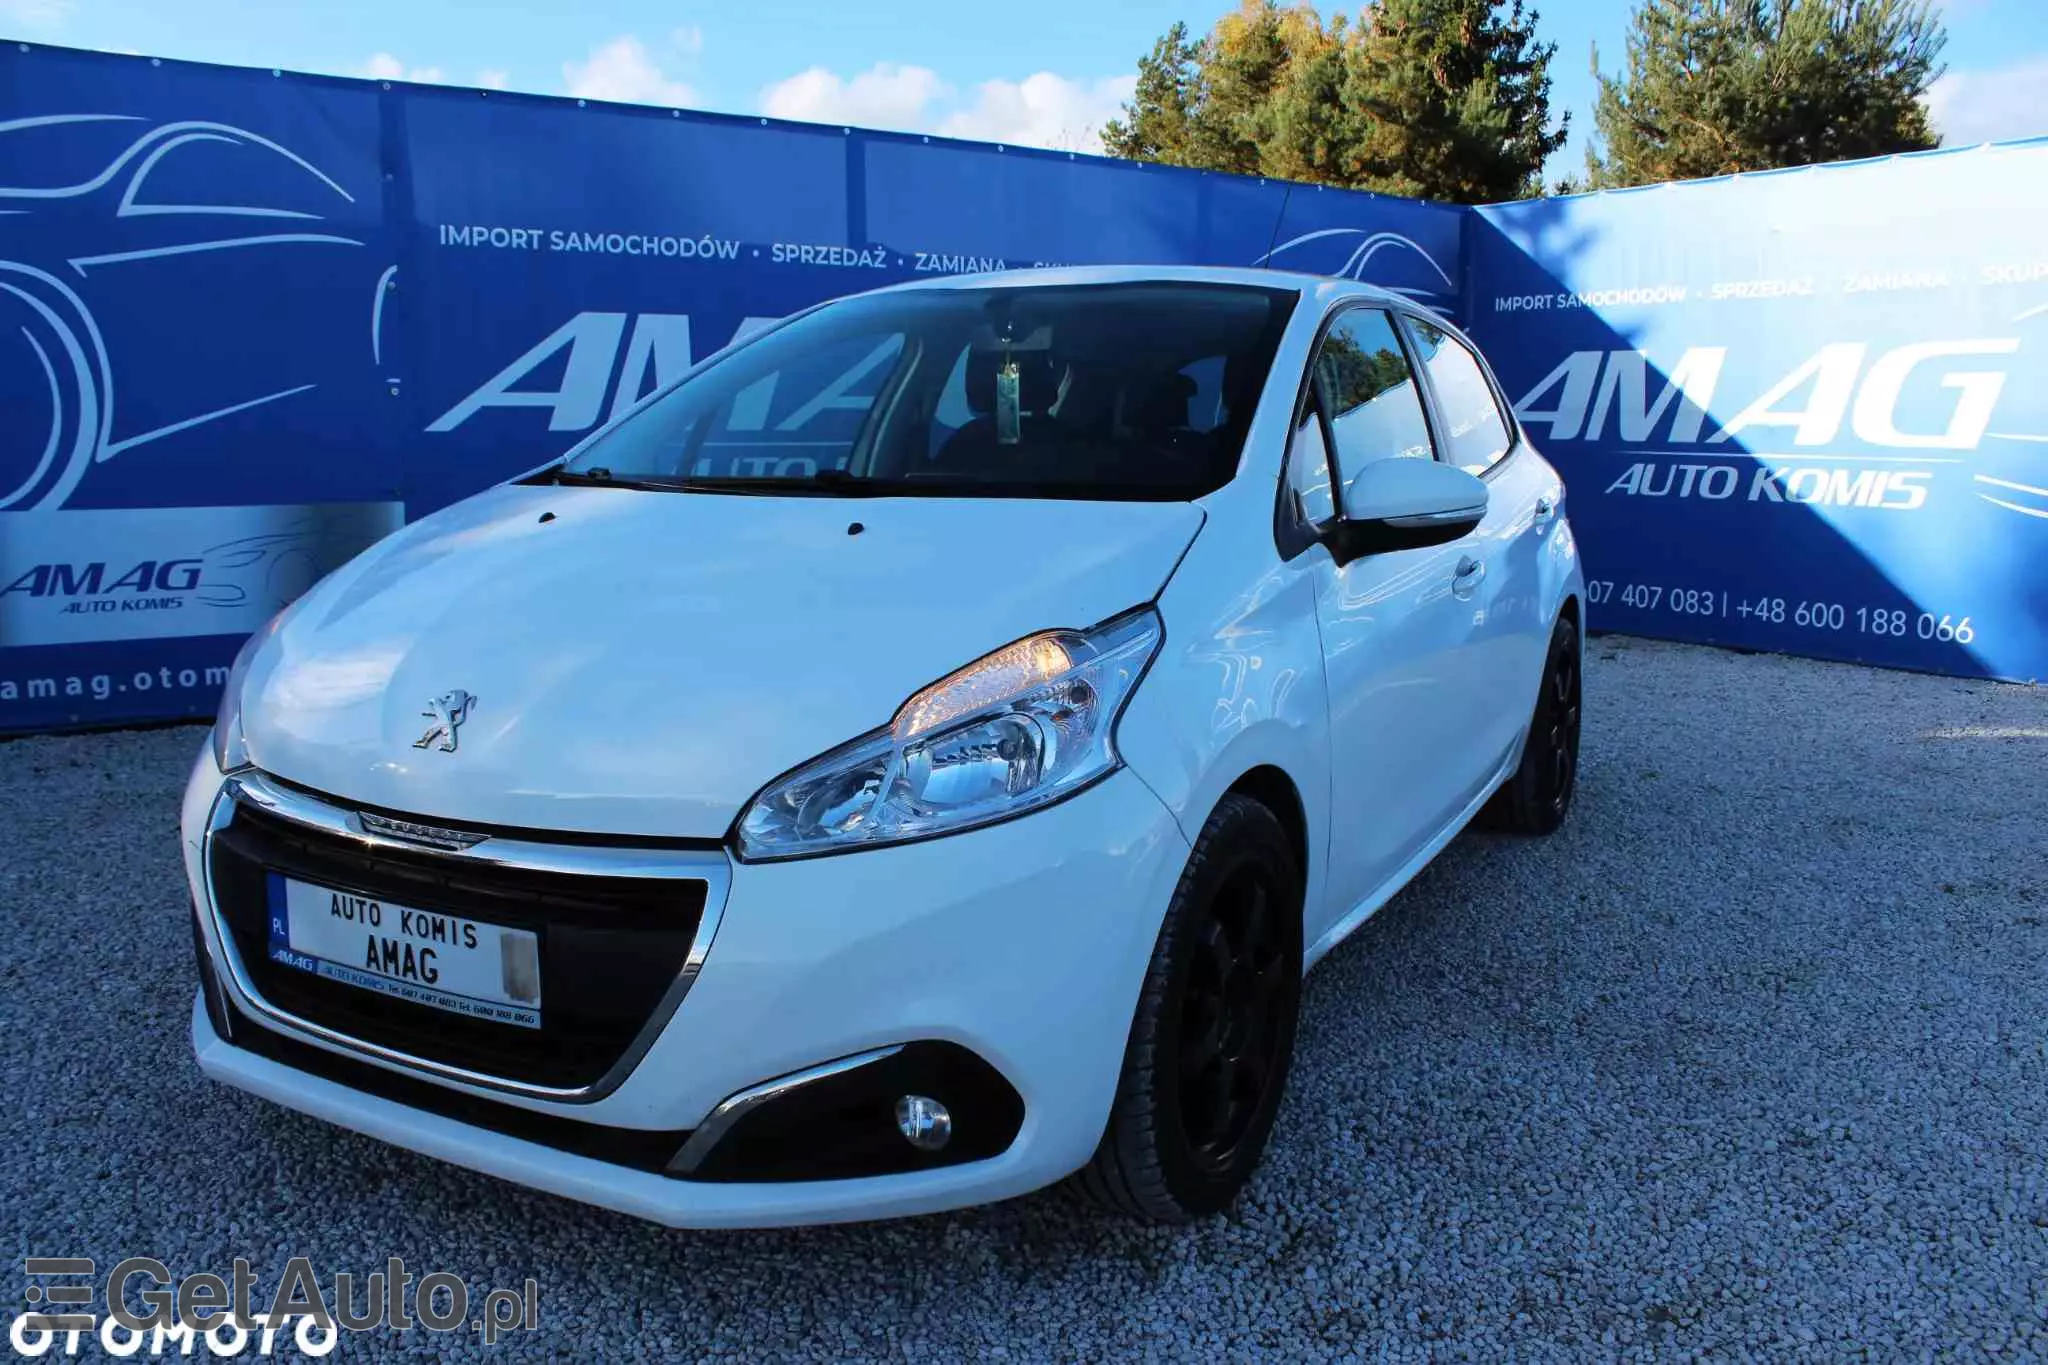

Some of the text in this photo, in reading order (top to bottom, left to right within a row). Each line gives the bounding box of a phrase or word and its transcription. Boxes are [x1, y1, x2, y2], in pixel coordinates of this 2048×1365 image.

[439, 224, 544, 250] IMPORT
[550, 230, 740, 260] SAMOCHODÓW
[771, 242, 887, 269] SPRZEDAŻ
[914, 252, 1007, 274] ZAMIANA
[1494, 293, 1554, 312] IMPORT
[1604, 463, 1933, 510] AUTO KOMIS
[58, 597, 184, 616] AUTO KOMIS
[1585, 580, 1614, 604] 07
[1621, 583, 1662, 609] 407
[1670, 588, 1713, 615] 083
[1736, 598, 1785, 624] +48
[1794, 601, 1845, 631] 600
[1856, 606, 1907, 636] 188
[1917, 612, 1974, 644] 066
[0, 666, 230, 700] amag.otom
[272, 917, 285, 936] PL
[331, 893, 478, 949] AUTO KOMIS
[366, 933, 438, 985] AMAG
